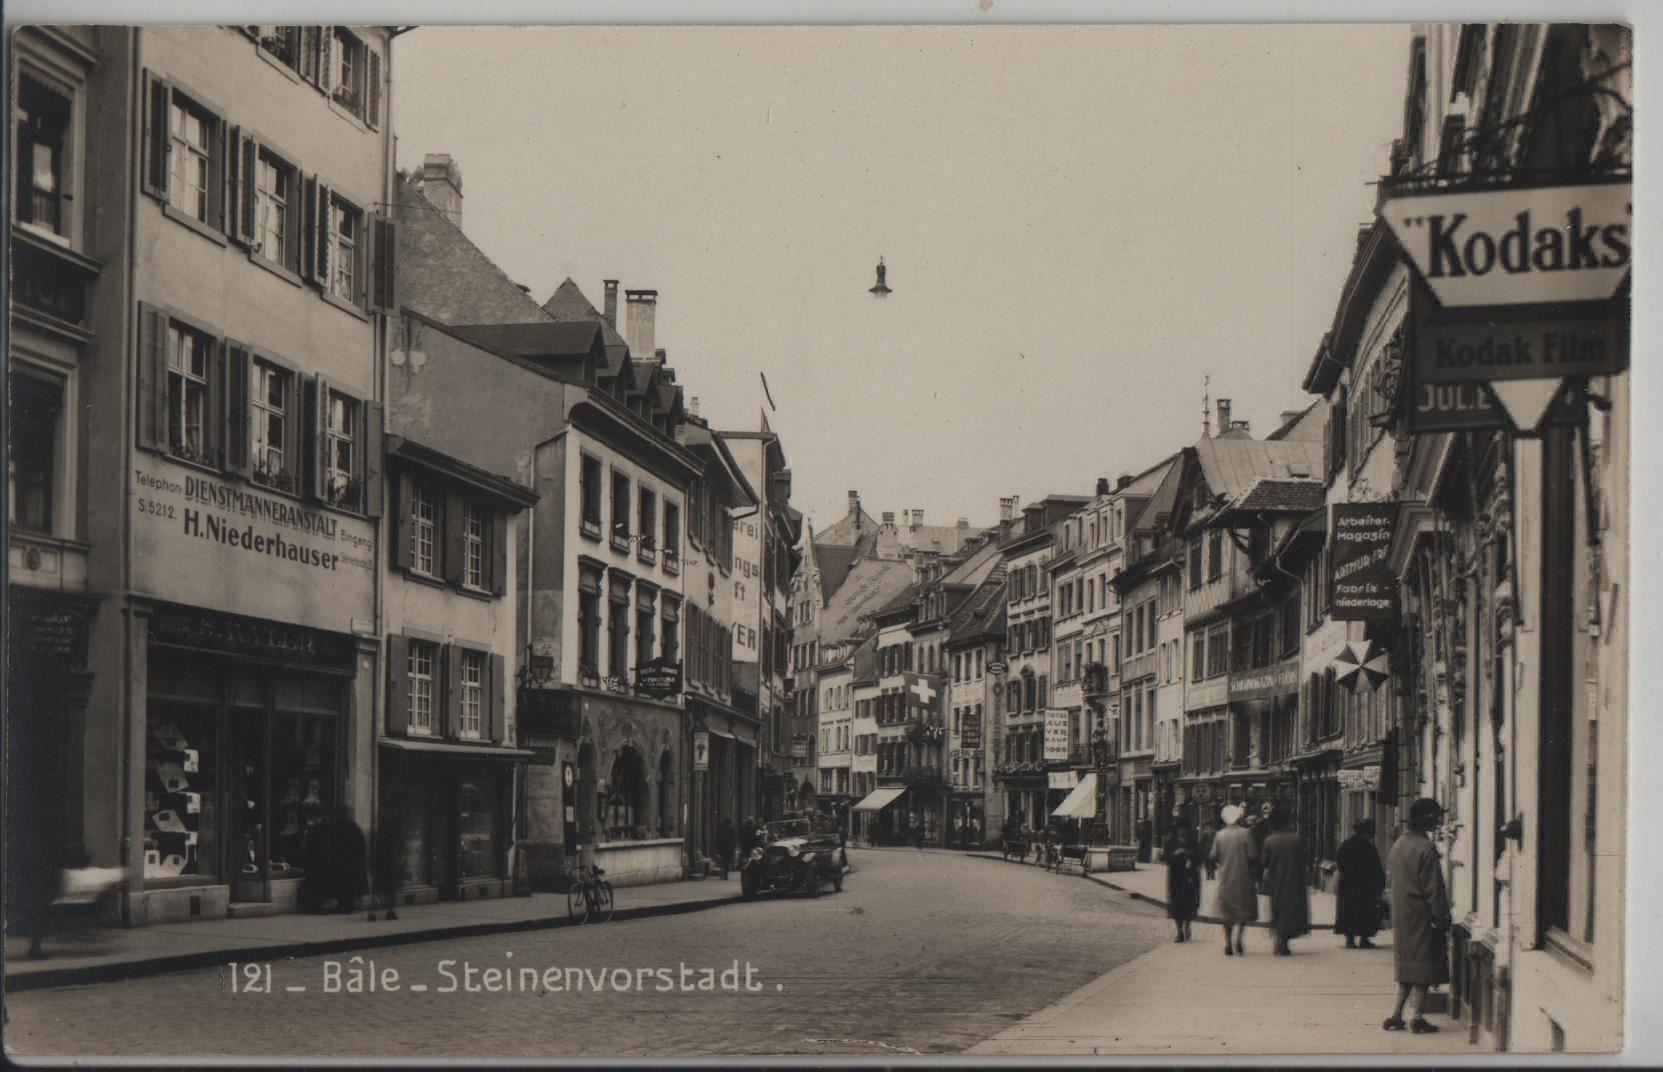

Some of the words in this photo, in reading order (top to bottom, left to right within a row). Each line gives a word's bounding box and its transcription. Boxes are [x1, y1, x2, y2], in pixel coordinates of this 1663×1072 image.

[1435, 335, 1533, 368] Kodak
[1541, 332, 1607, 364] Film
[184, 508, 339, 571] H.Niederhauser
[1337, 528, 1390, 542] Magazin
[1334, 555, 1369, 582] ARTHUR
[1336, 582, 1377, 593] Fabrik
[1336, 596, 1390, 608] niederlage
